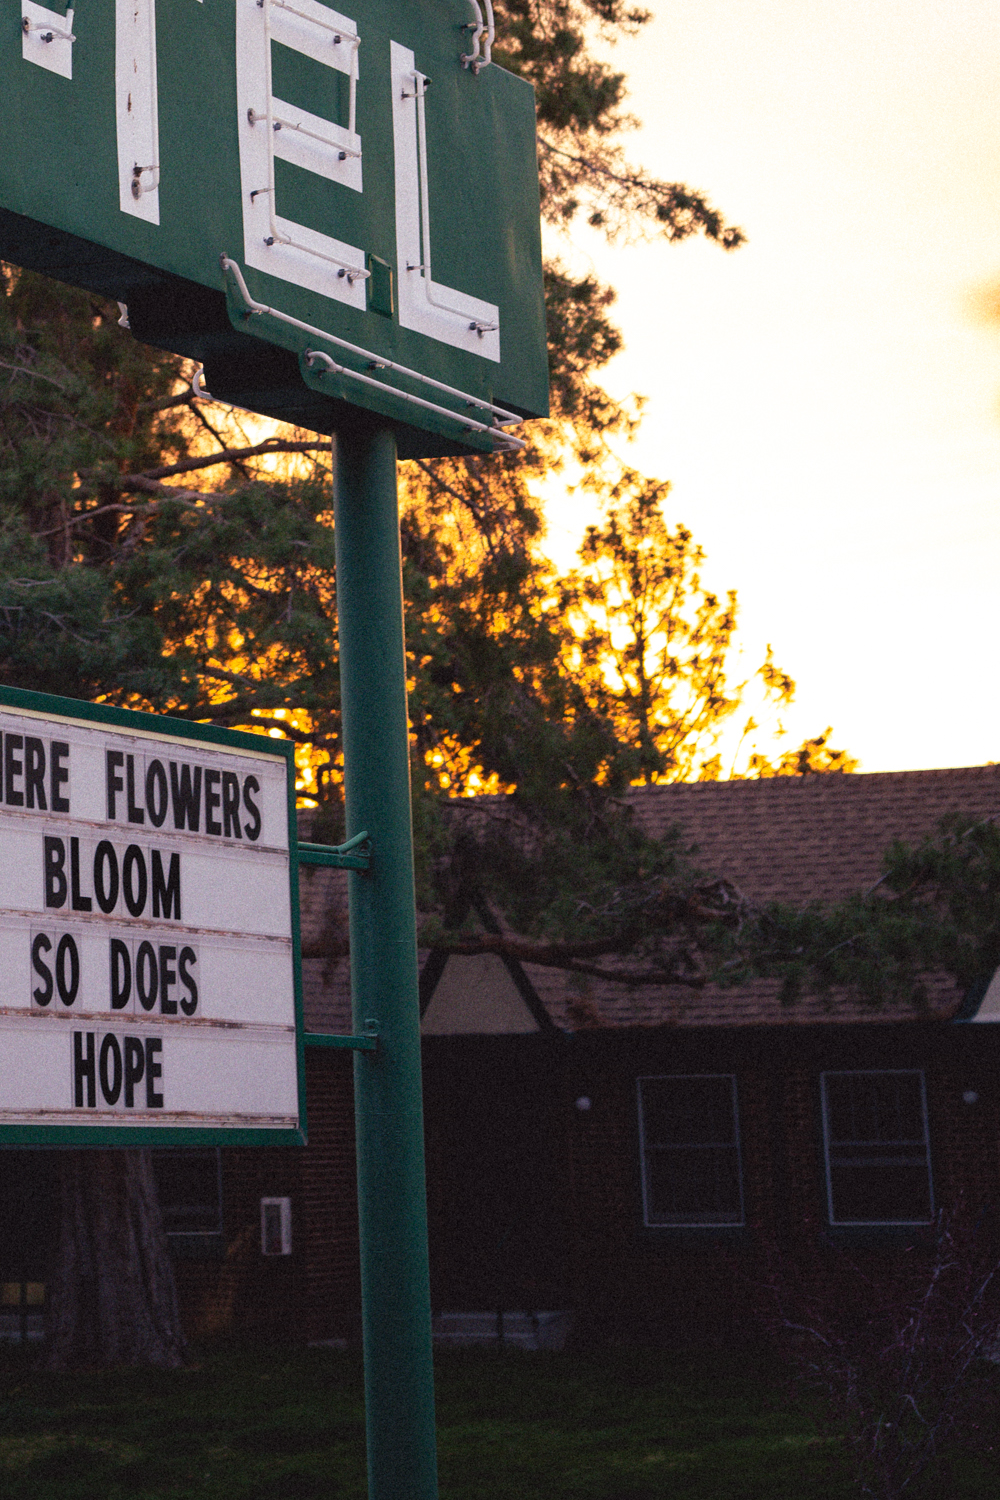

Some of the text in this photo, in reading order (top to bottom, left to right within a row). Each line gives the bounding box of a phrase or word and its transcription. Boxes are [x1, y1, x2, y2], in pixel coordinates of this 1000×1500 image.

[106, 750, 262, 841] FLOWERS
[44, 835, 182, 920] BLOOM
[32, 932, 198, 1016] SO DOES
[74, 1031, 164, 1108] HOPE
